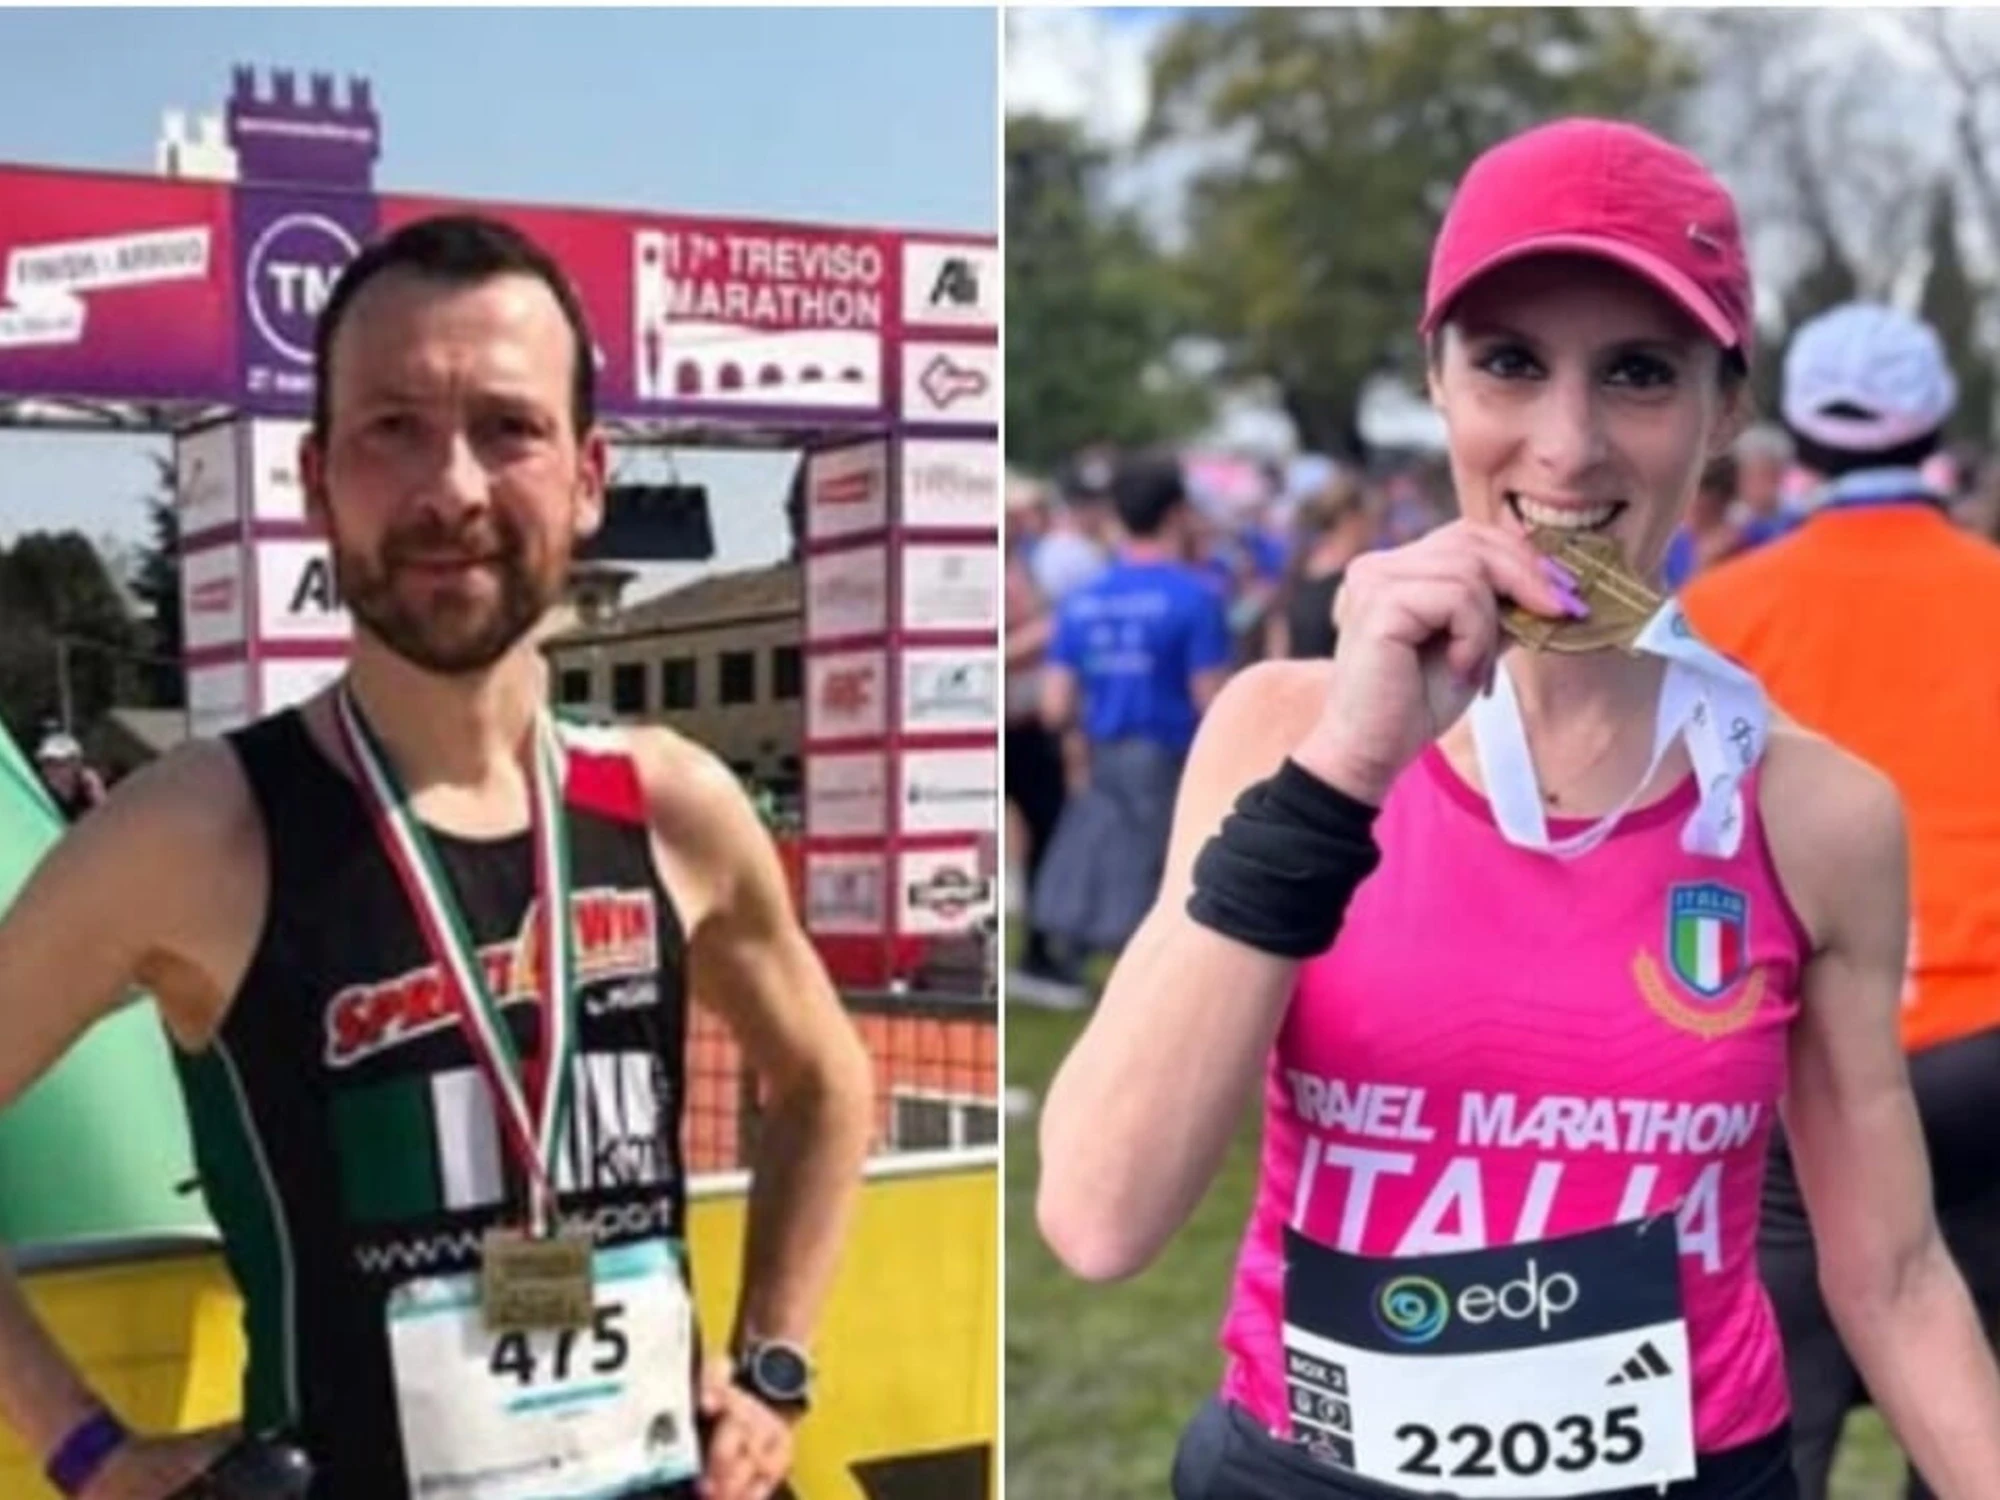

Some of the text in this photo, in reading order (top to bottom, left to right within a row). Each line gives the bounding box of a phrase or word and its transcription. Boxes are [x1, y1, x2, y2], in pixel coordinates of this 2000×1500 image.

[726, 234, 883, 285] TREVISO
[665, 277, 882, 328] MARATHON
[1455, 1089, 1762, 1153] MARATHON
[1456, 1257, 1581, 1331] edp
[1393, 1404, 1646, 1478] 22035
